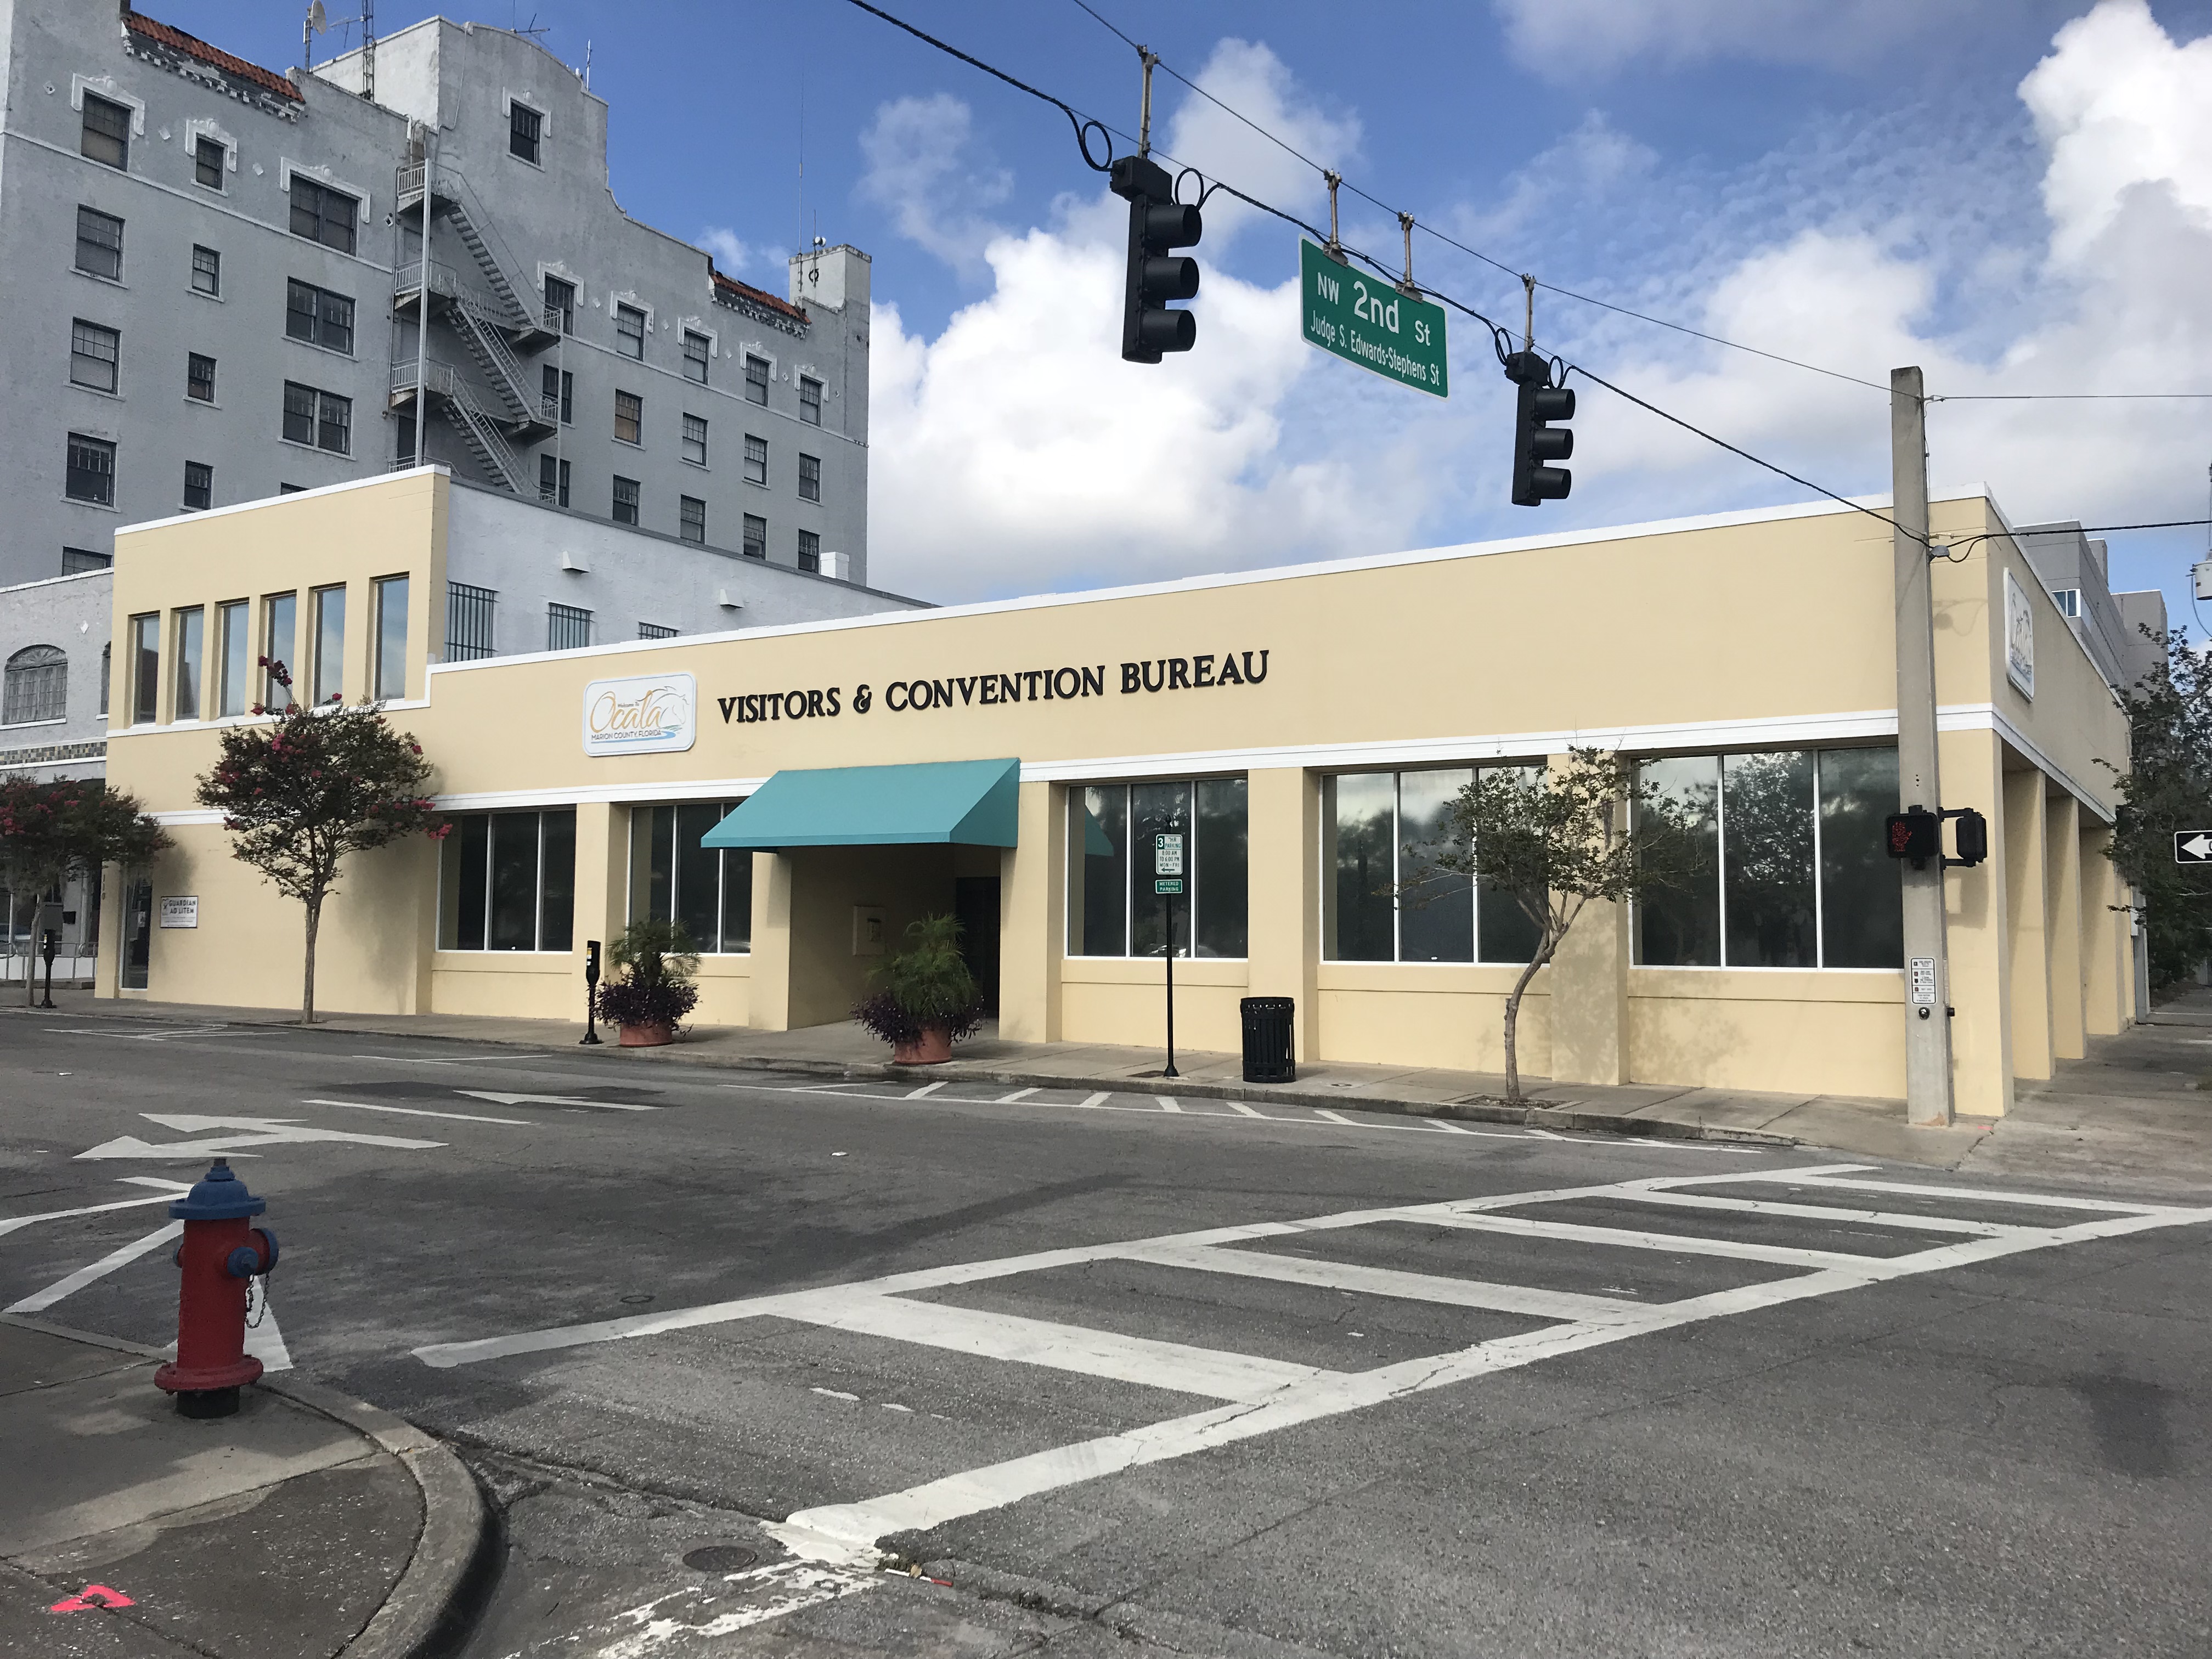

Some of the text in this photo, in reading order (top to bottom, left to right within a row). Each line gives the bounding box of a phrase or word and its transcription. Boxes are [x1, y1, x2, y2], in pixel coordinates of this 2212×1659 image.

[1318, 272, 1431, 346] NW 2nd St
[1311, 309, 1440, 386] Judge S. Edwards-Stephens St
[590, 690, 662, 733] Ocala
[717, 650, 1269, 724] VISITORS & CONVENTION BUREAU
[1158, 838, 1164, 848] 3
